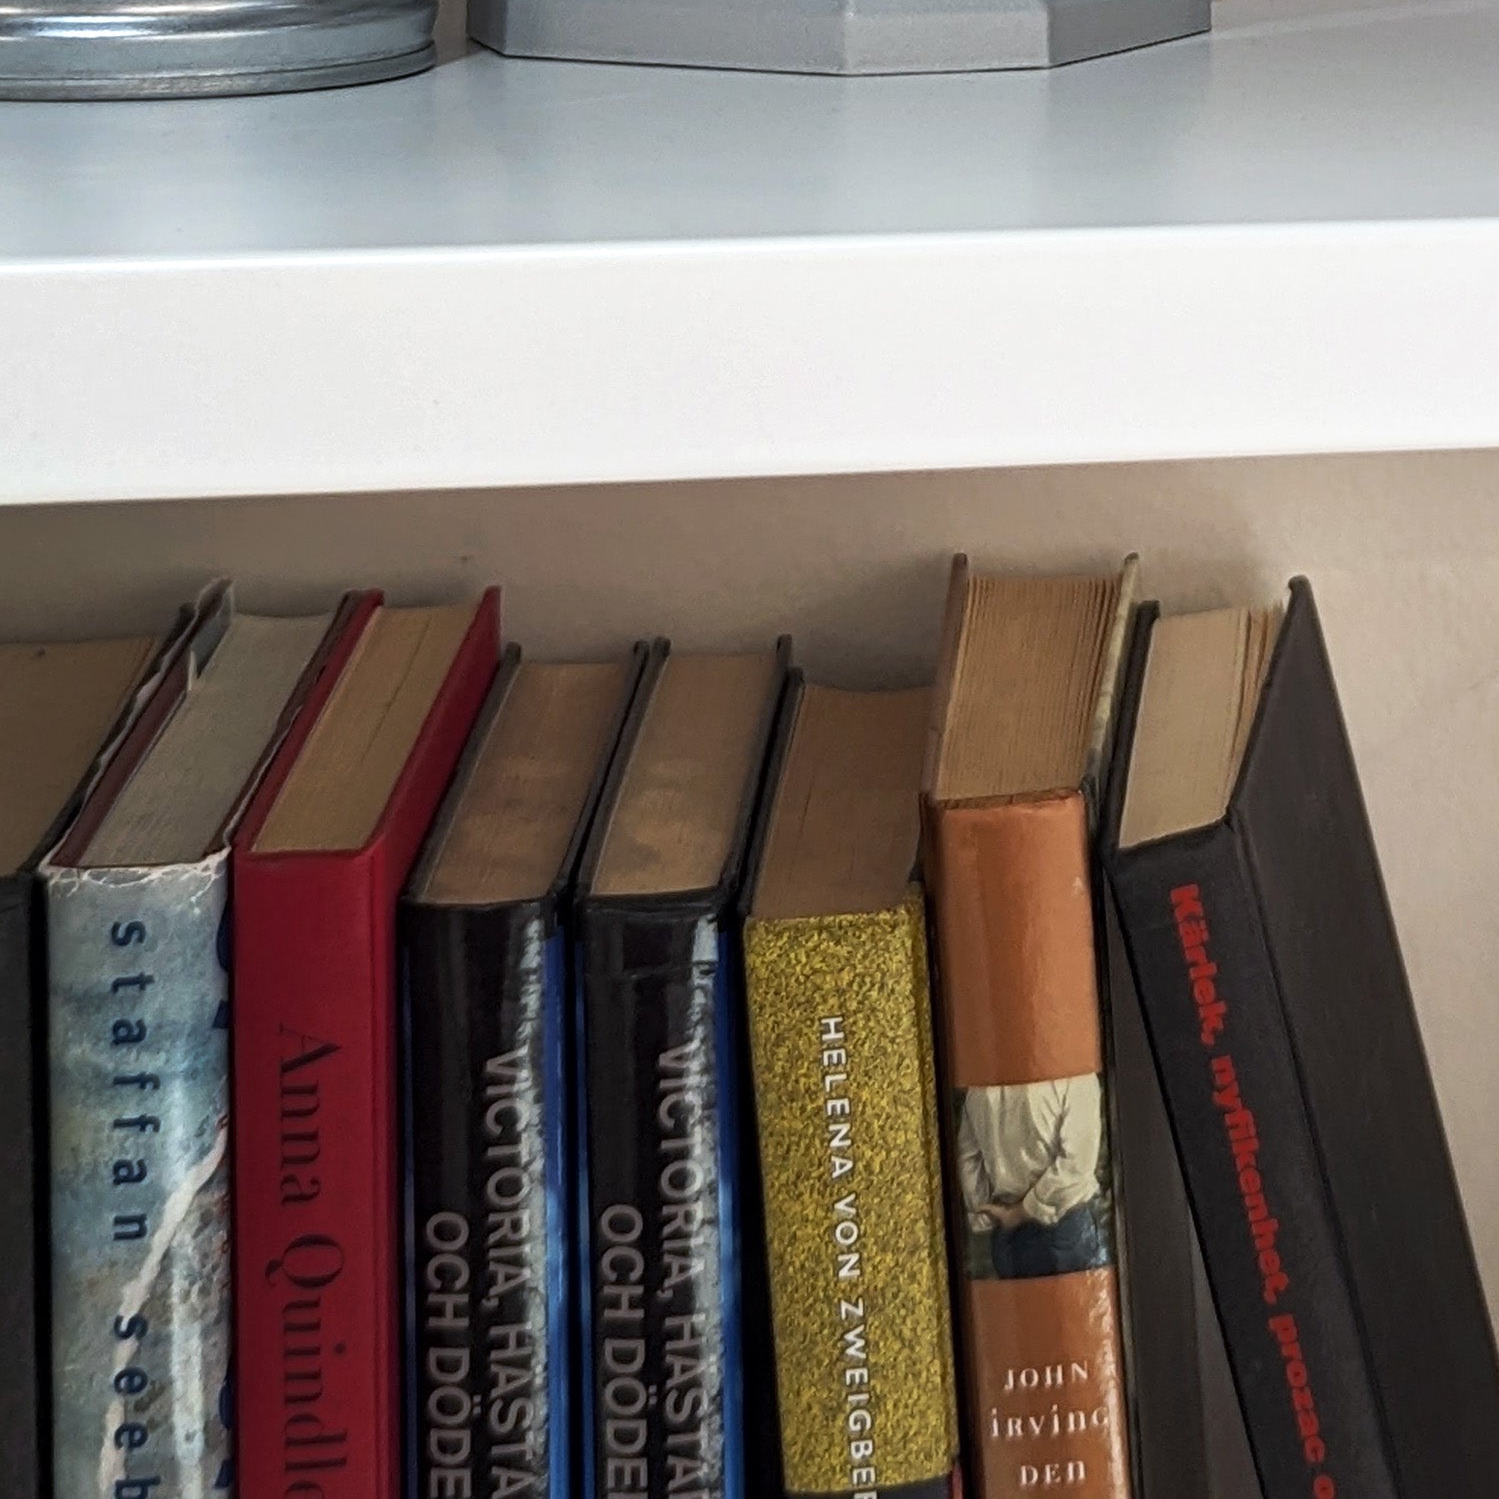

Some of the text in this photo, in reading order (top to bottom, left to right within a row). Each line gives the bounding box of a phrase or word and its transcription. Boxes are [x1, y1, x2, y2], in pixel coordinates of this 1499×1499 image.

[1169, 883, 1227, 1048] Kärlek,
[109, 919, 161, 1243] staffan
[278, 1022, 343, 1206] Anna
[482, 1043, 532, 1308] VICTORIA,
[656, 1036, 706, 1299] VICTORIA,
[820, 1016, 855, 1179] HELENA
[834, 1192, 861, 1281] VON
[425, 1210, 482, 1499] OCH DÖDE
[600, 1203, 658, 1499] OCH DÖDE
[1003, 1360, 1089, 1391] JOHN
